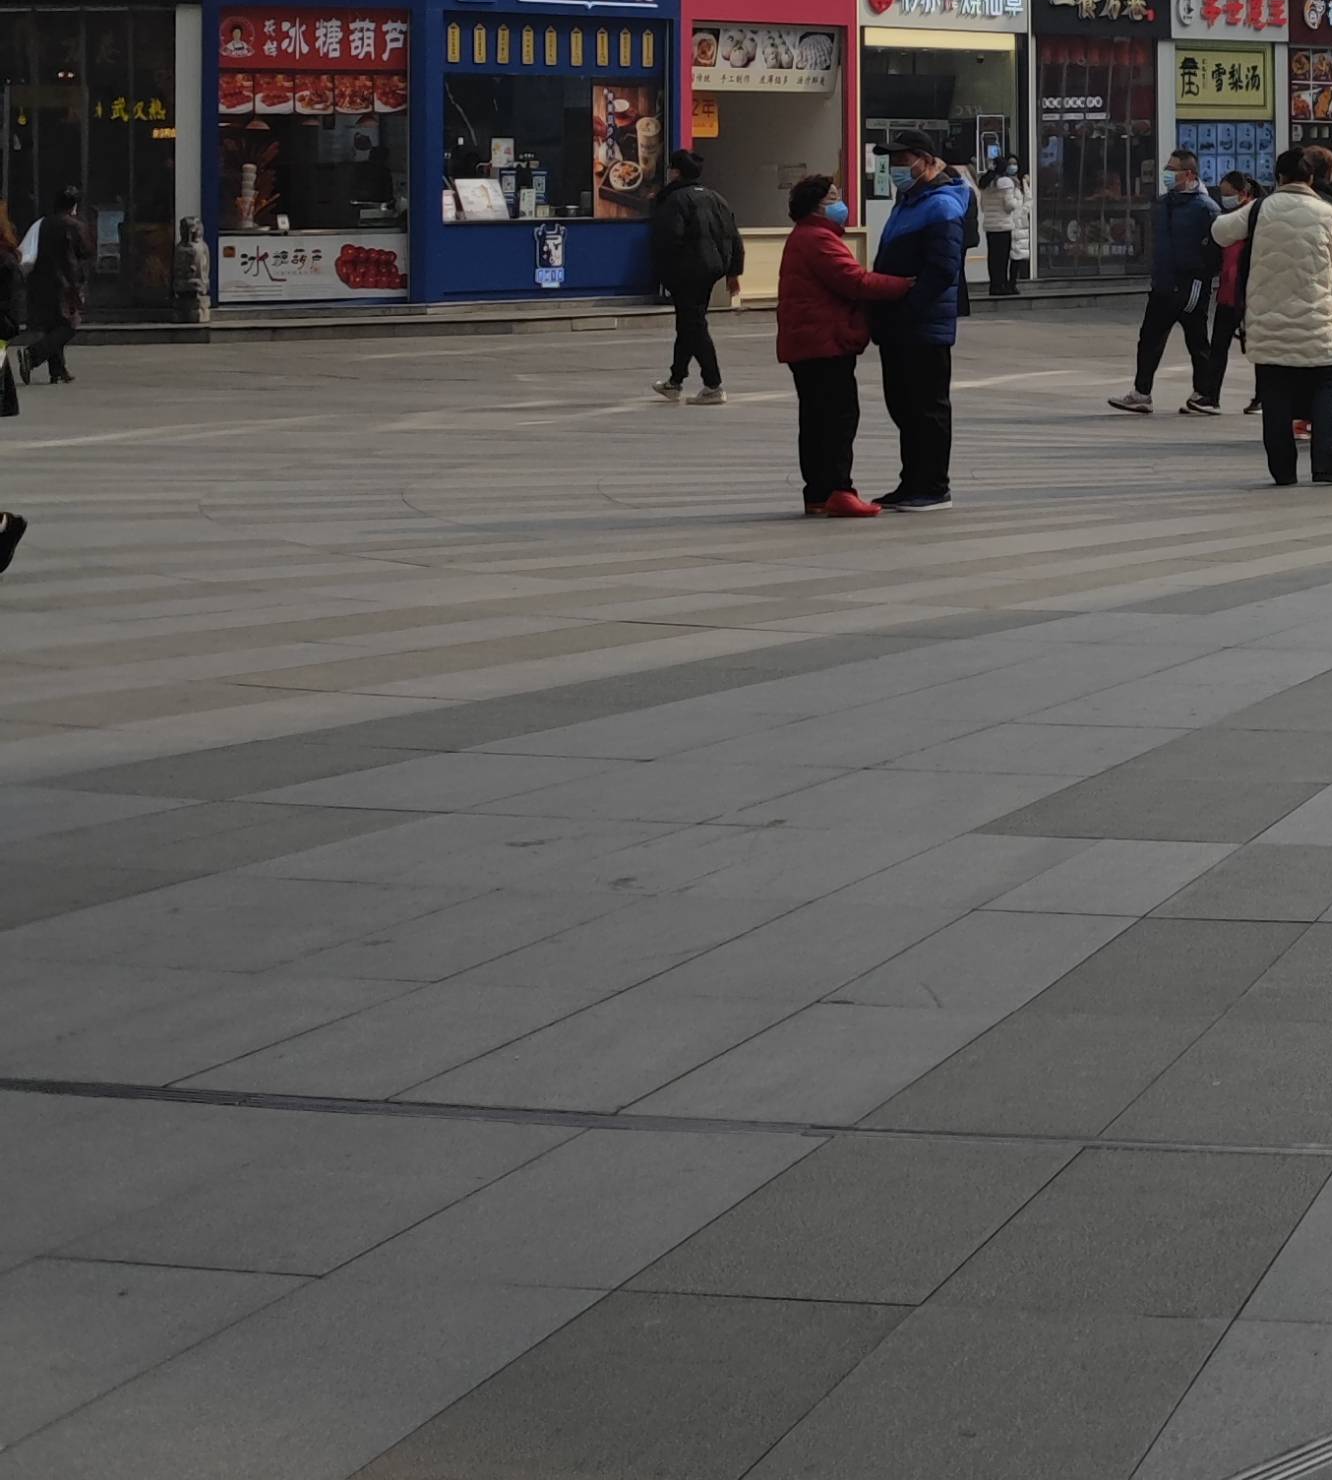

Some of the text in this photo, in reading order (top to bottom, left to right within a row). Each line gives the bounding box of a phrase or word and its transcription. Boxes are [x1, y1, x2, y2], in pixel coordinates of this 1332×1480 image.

[281, 17, 408, 62] 冰糖葫芦
[1211, 63, 1261, 93] 雪梨汤
